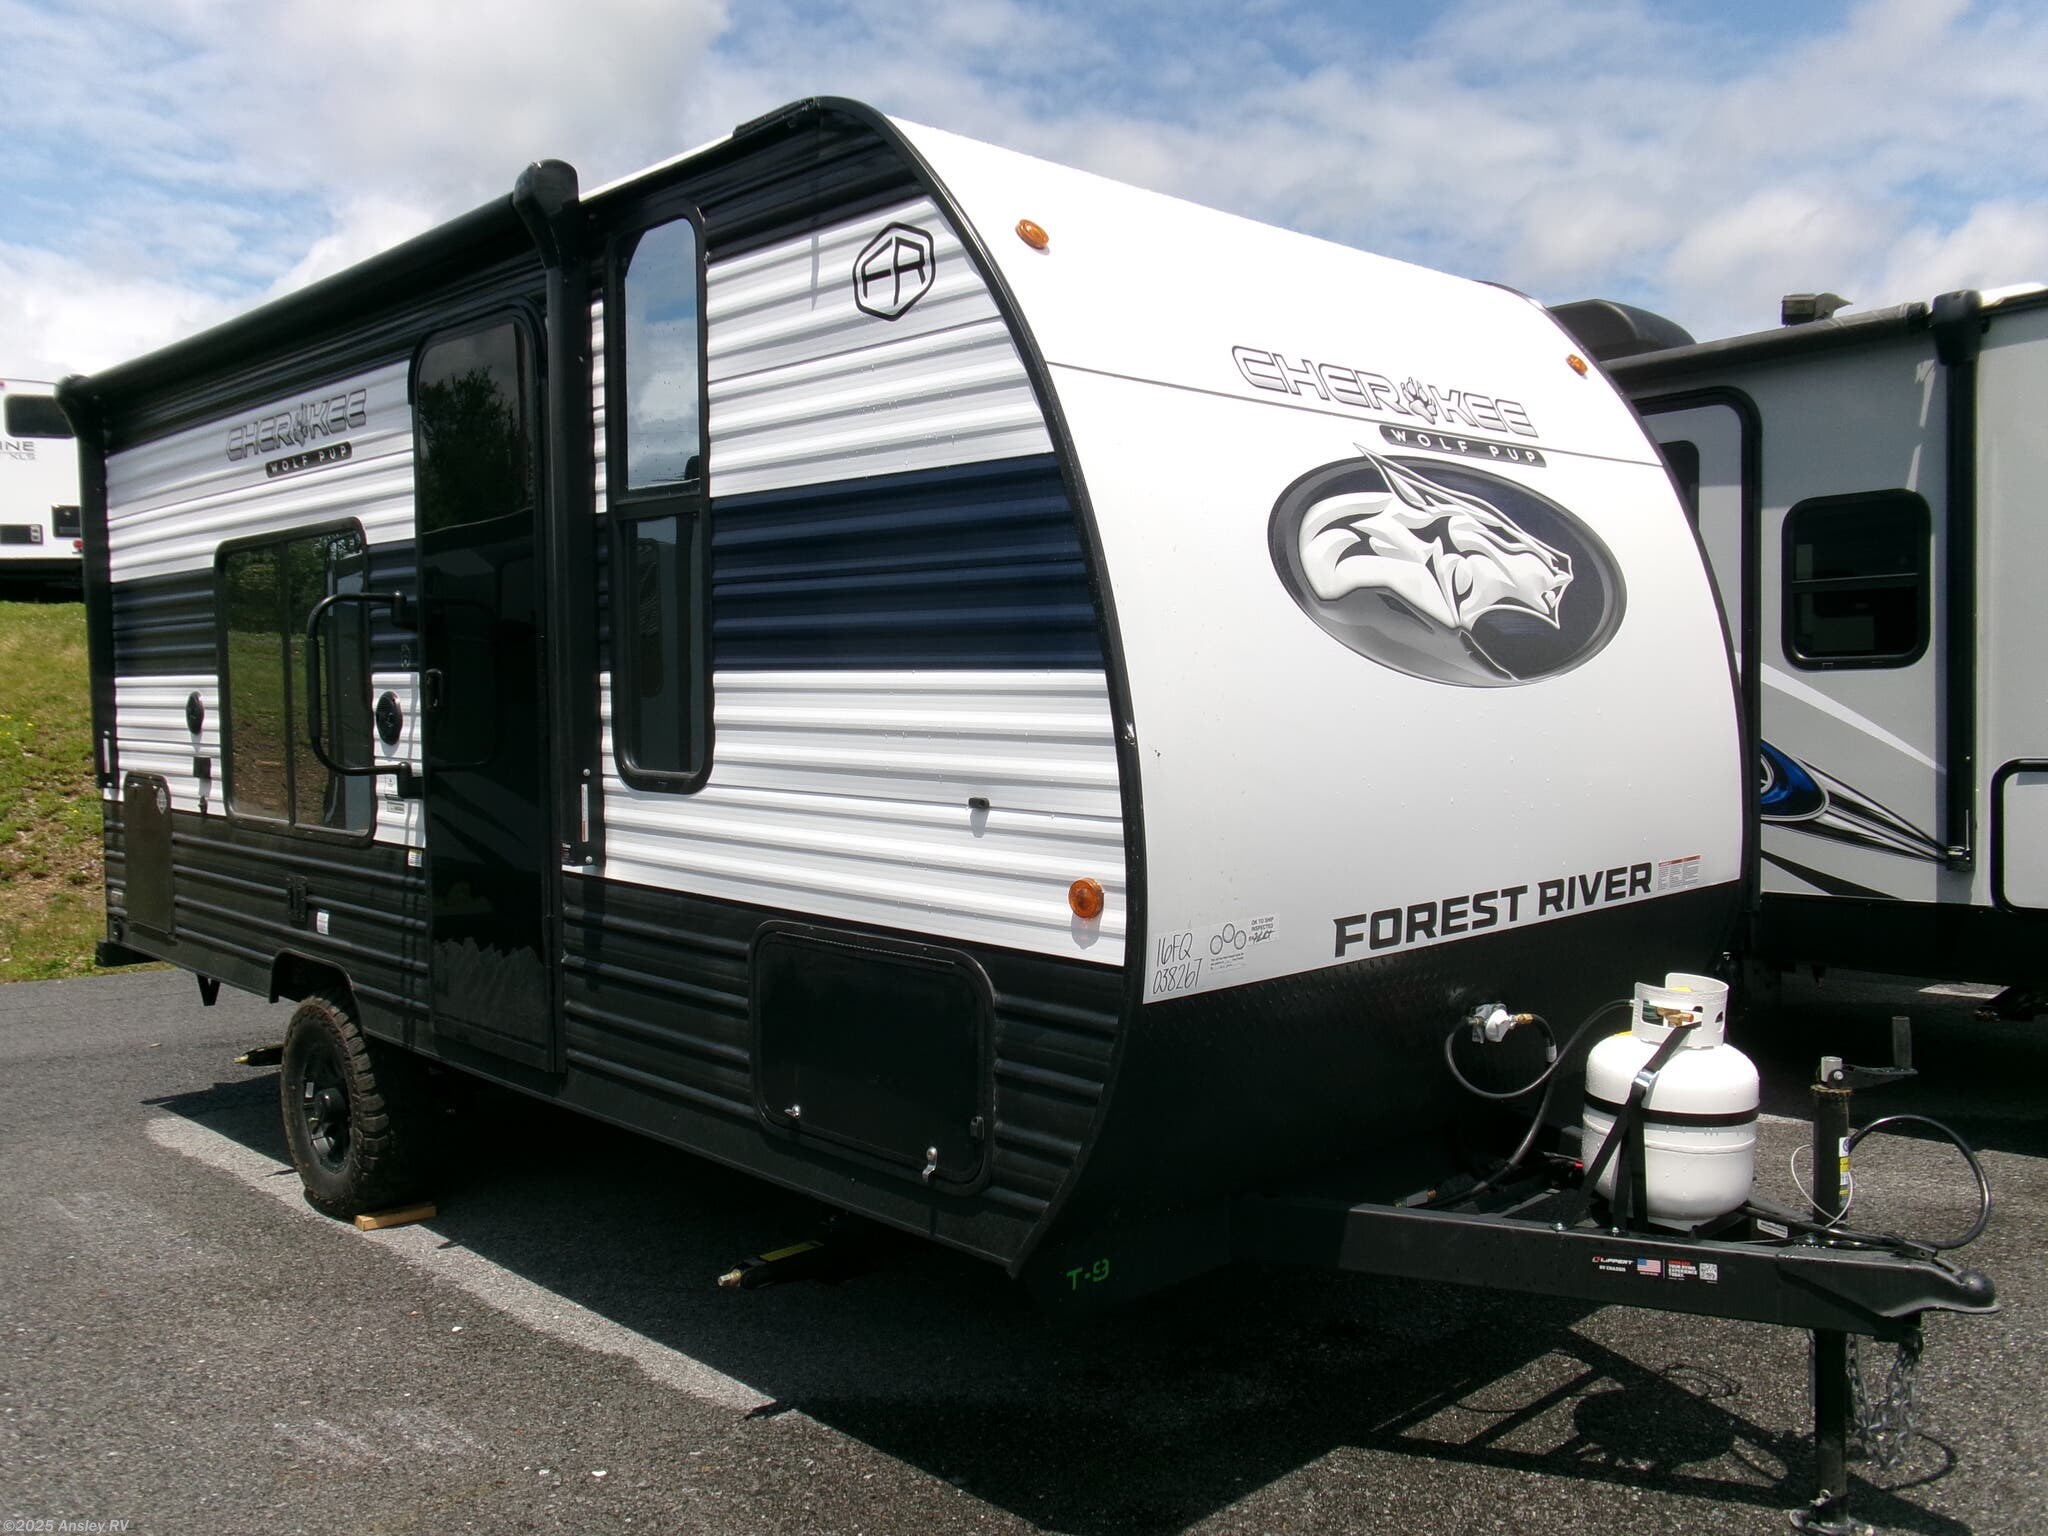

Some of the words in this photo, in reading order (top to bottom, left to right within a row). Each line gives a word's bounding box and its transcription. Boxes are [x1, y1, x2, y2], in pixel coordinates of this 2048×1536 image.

[1232, 345, 1539, 439] CHEROKEE
[226, 388, 367, 462] CHEROKEE
[1390, 428, 1470, 453] WOLF
[1490, 445, 1537, 464] PUP
[271, 455, 308, 474] WOLF
[319, 445, 348, 461] PUP
[1332, 885, 1528, 958] FOREST
[1537, 862, 1652, 916] RIVER
[1600, 1257, 1634, 1265] LIPPERT
